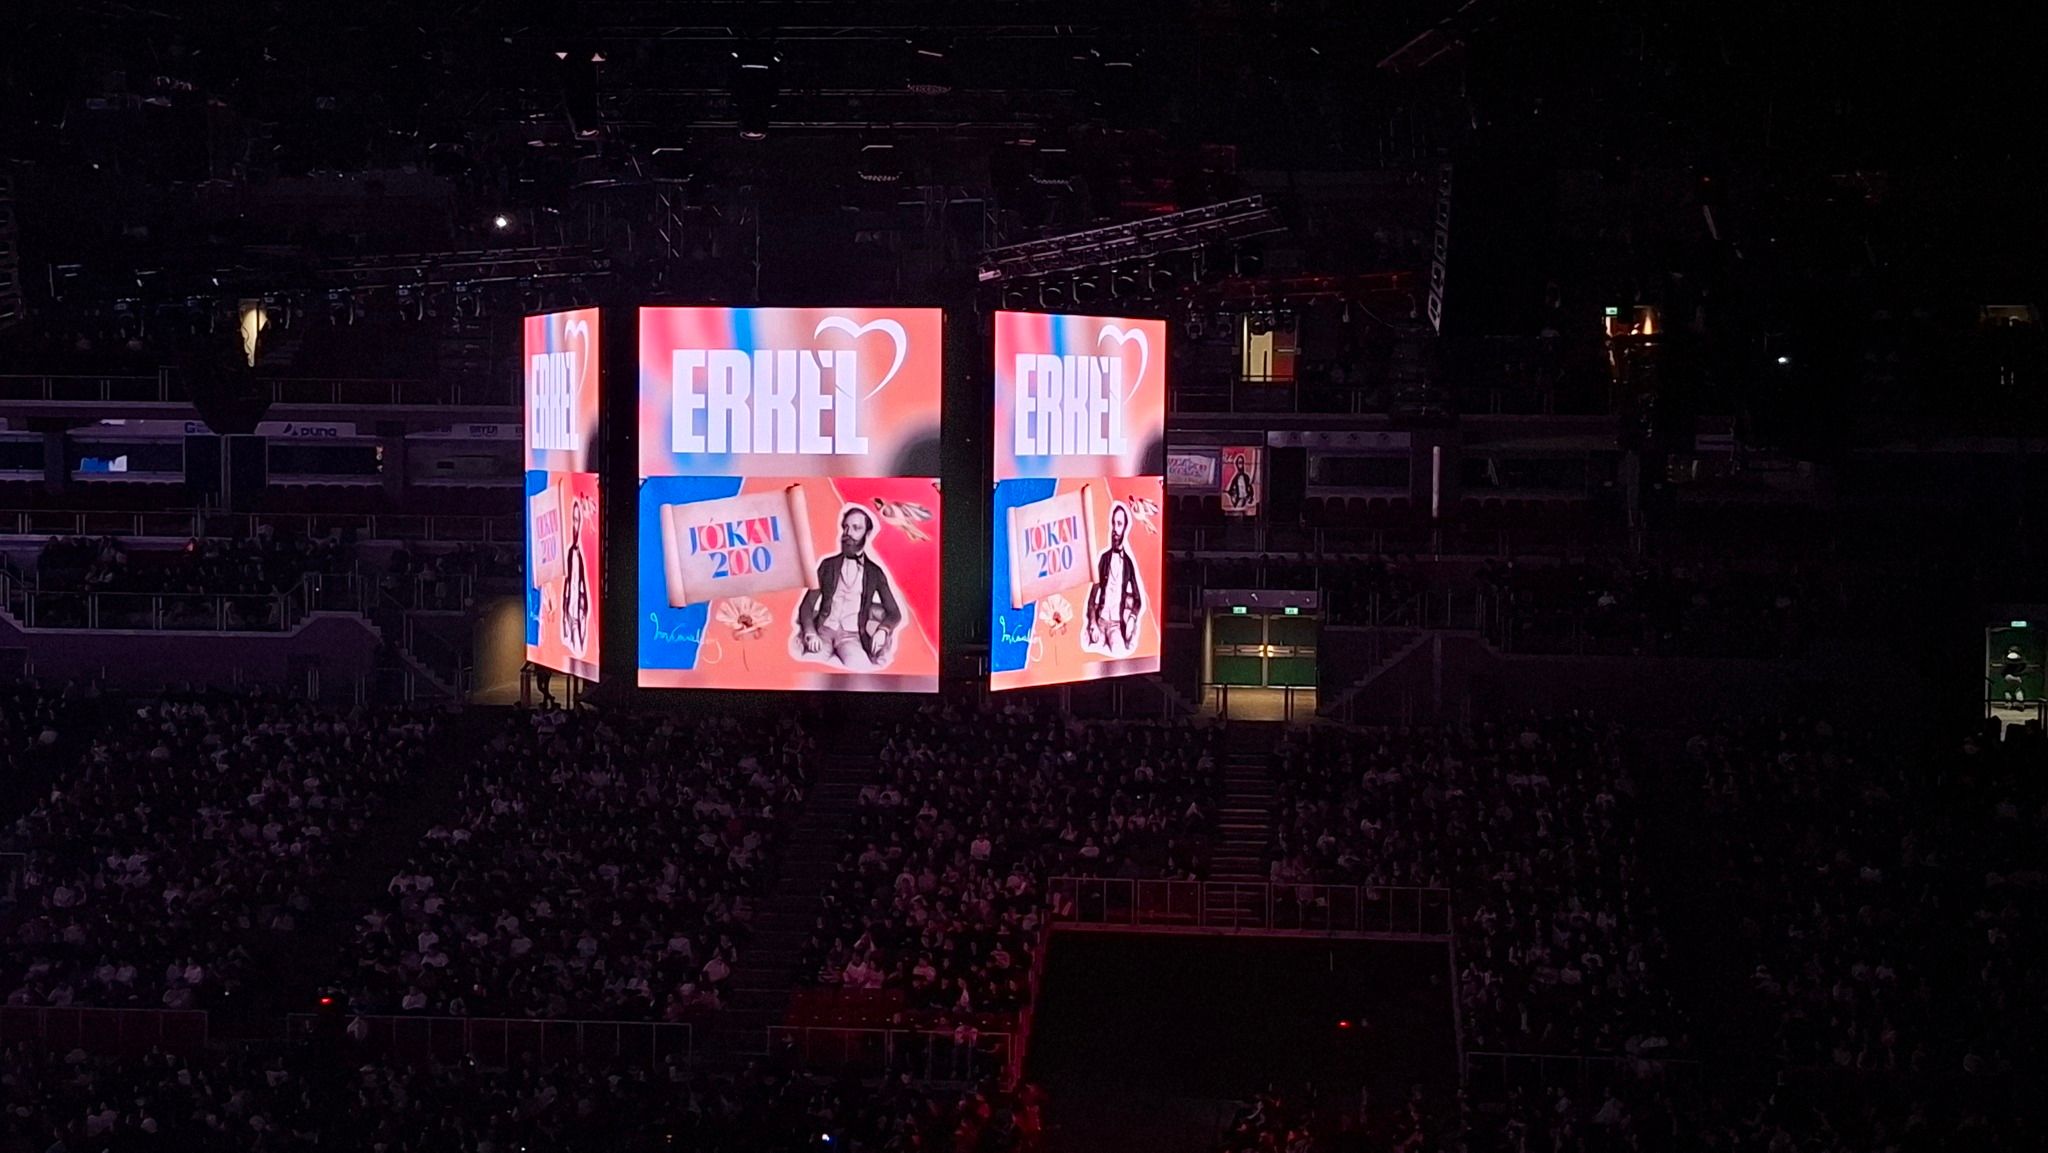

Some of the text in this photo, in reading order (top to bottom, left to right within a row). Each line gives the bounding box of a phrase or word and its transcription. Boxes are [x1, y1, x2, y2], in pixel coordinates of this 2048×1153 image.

[531, 352, 578, 450] ERKEL
[672, 349, 869, 455] ERKEL
[1014, 353, 1127, 457] ERKEL
[689, 517, 781, 556] JÓKAI
[1025, 516, 1078, 557] JÓKAI
[708, 546, 771, 579] 200
[1036, 545, 1073, 578] 200
